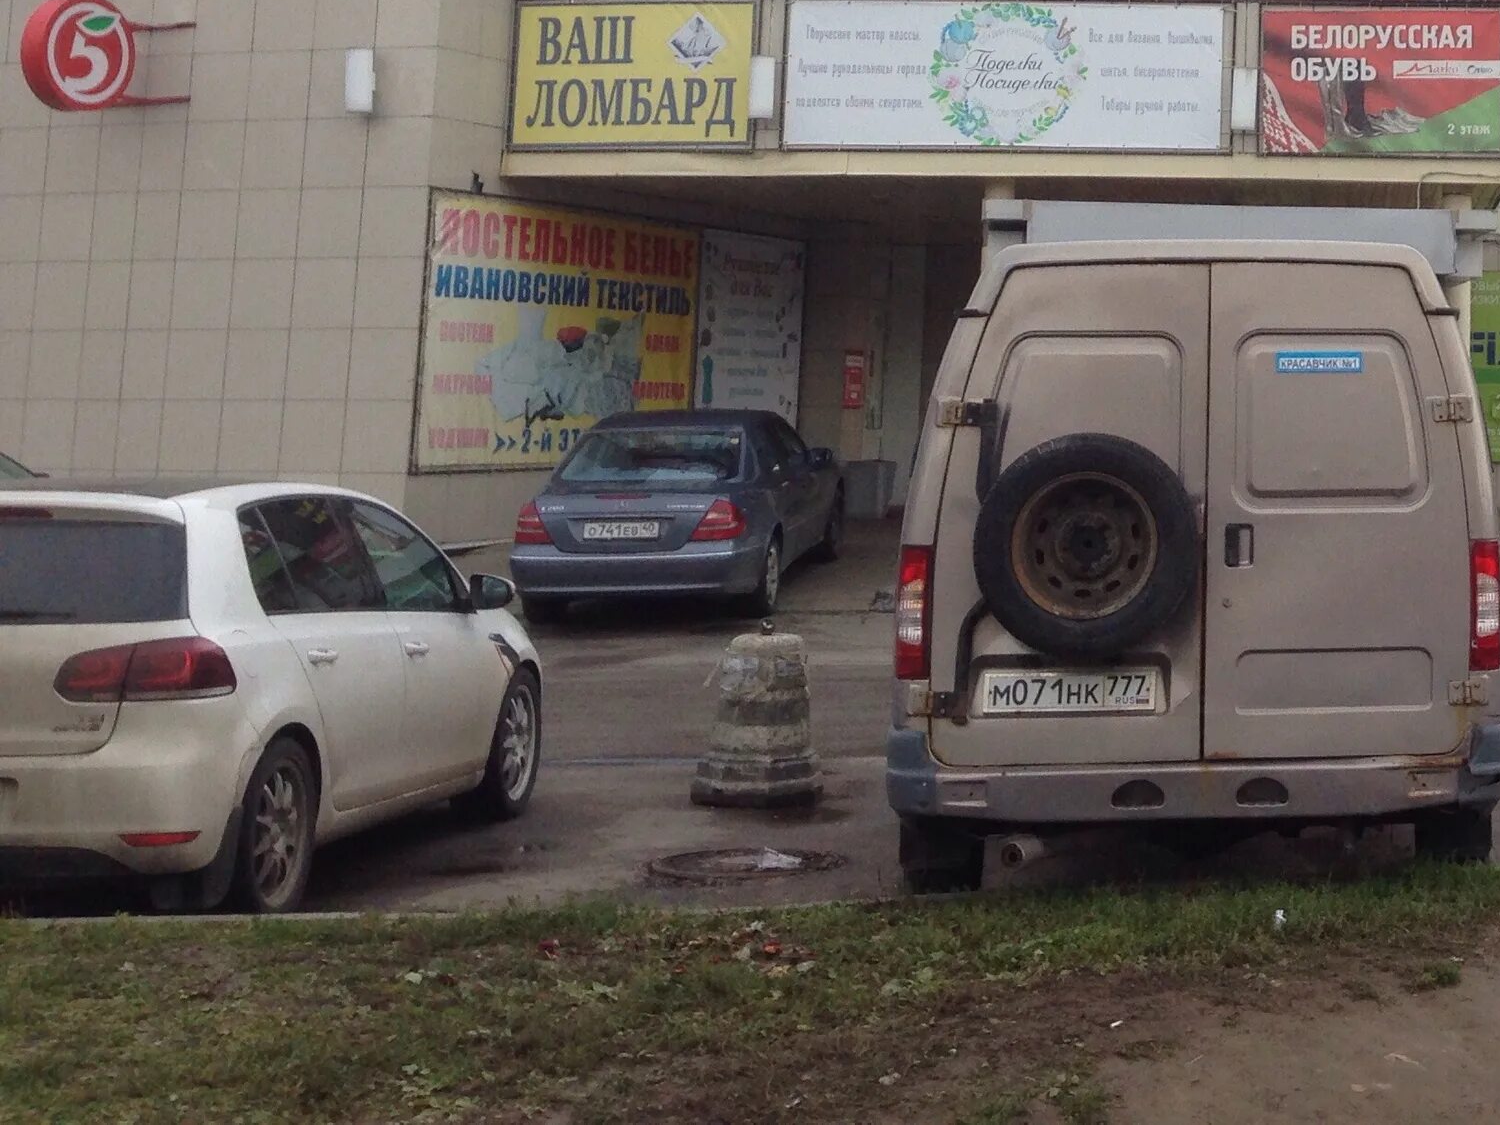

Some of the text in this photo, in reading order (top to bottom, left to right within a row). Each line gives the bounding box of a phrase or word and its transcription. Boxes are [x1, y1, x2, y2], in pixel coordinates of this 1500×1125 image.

[536, 16, 636, 65] ВАШ
[1291, 25, 1473, 49] БЕЛОРУССКАЯ
[966, 49, 1043, 74] Поделки
[1291, 57, 1377, 82] ОБУВЬ
[964, 69, 1059, 94] Посиделки
[526, 78, 737, 137] ЛОМБАРД
[1447, 123, 1490, 135] 2 этаж
[442, 208, 616, 270] ПОСТЕЛЬНОЕ
[623, 230, 694, 280] БЕЛЬЕ
[434, 264, 591, 308] ИВАНОВСКИЙ
[596, 277, 690, 317] ТЕКСТИЛЬ
[1281, 359, 1339, 368] КРАСАВЧИК
[1106, 675, 1147, 695] 777
[1115, 696, 1135, 704] RUS
